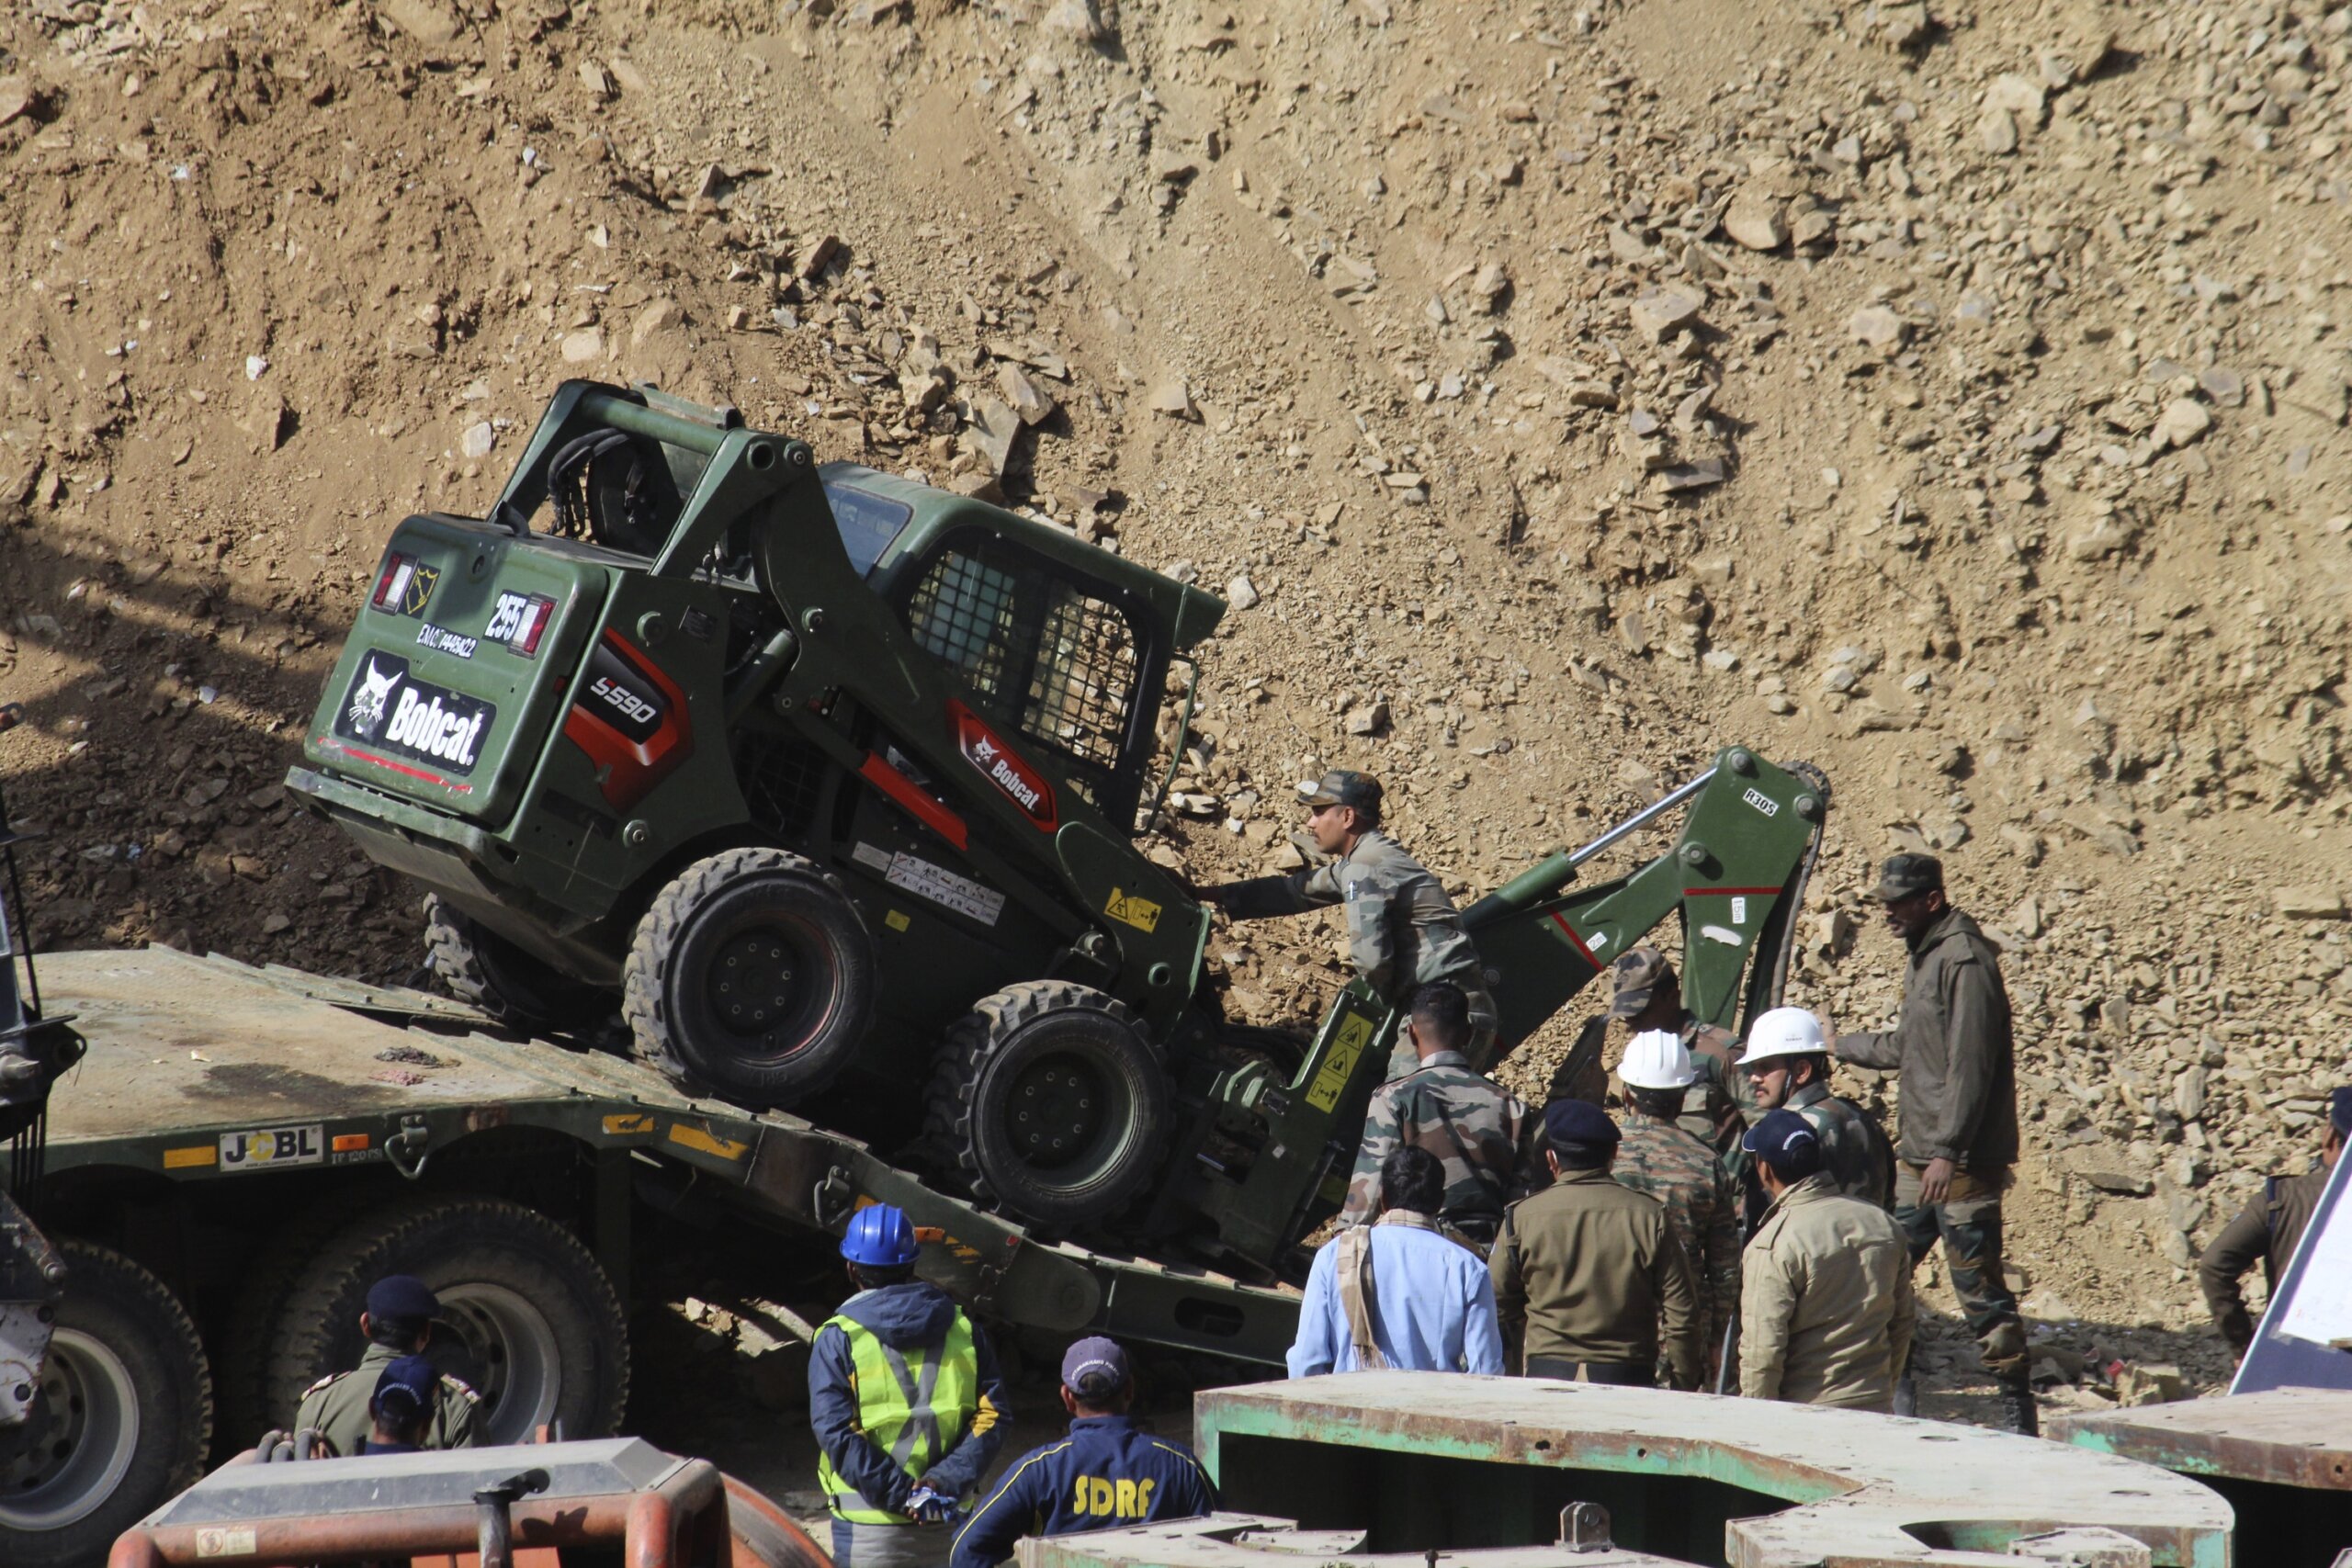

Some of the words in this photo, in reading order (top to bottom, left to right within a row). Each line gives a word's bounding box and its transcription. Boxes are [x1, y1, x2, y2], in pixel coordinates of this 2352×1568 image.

[484, 593, 527, 641] 255
[590, 677, 657, 723] S590
[385, 686, 483, 765] Bobcat
[991, 759, 1040, 811] Bobcat
[1746, 790, 1776, 814] R30S
[225, 1129, 317, 1163] JCBL
[348, 1150, 367, 1163] 120
[1073, 1475, 1155, 1517] SDRF
